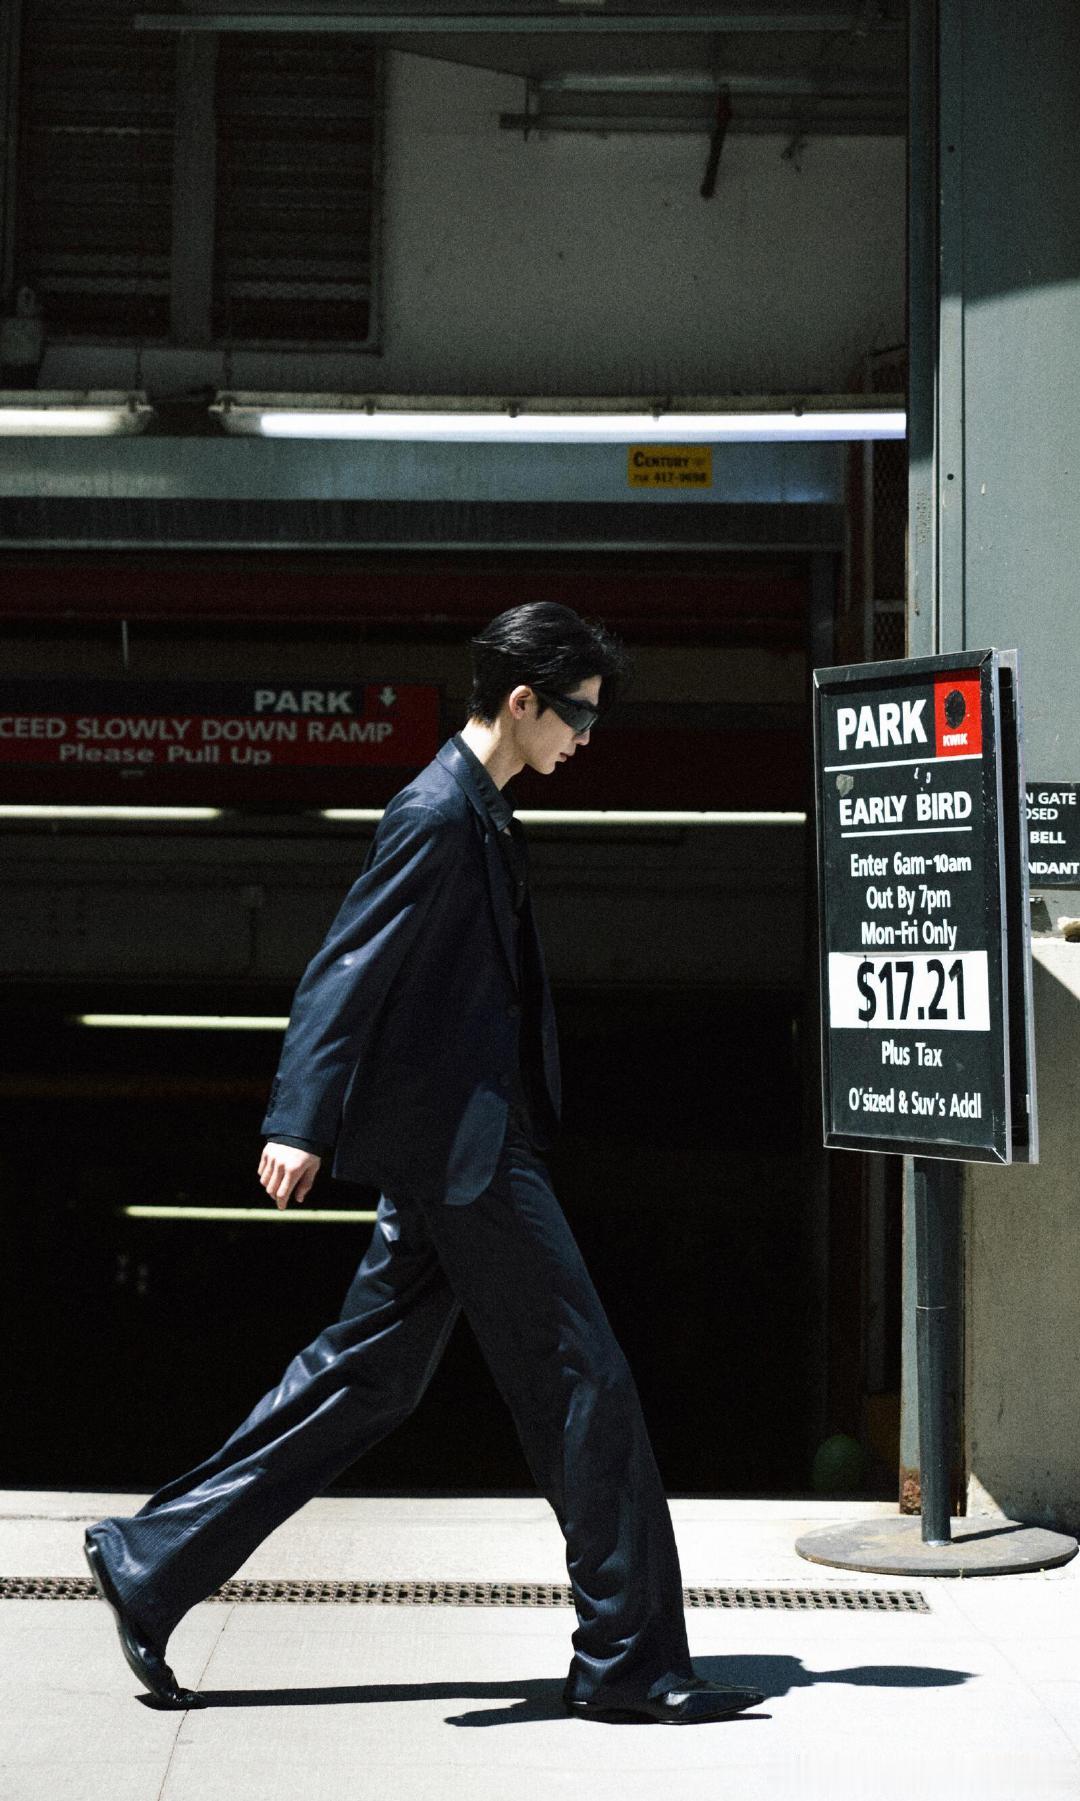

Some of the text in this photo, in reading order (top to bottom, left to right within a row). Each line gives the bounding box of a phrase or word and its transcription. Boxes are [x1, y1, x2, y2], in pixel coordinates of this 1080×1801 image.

[254, 690, 351, 712] PARK
[0, 718, 393, 742] CEED SLOWLY DOWN RAMP
[837, 699, 928, 750] PARK
[943, 733, 968, 747] KWIK
[59, 744, 271, 765] Please Pull Up
[839, 791, 972, 825] EARLY BIRD
[1038, 792, 1077, 805] GATE
[1030, 831, 1067, 844] BELL
[850, 852, 972, 877] Enter 6am-10am
[866, 885, 951, 915] Out By 7pm
[861, 919, 957, 951] Mon-Fri Only
[857, 957, 965, 1024] $17.21
[881, 1039, 943, 1067] Plus Tax
[849, 1087, 982, 1119] O'sized & Suv's Addl
